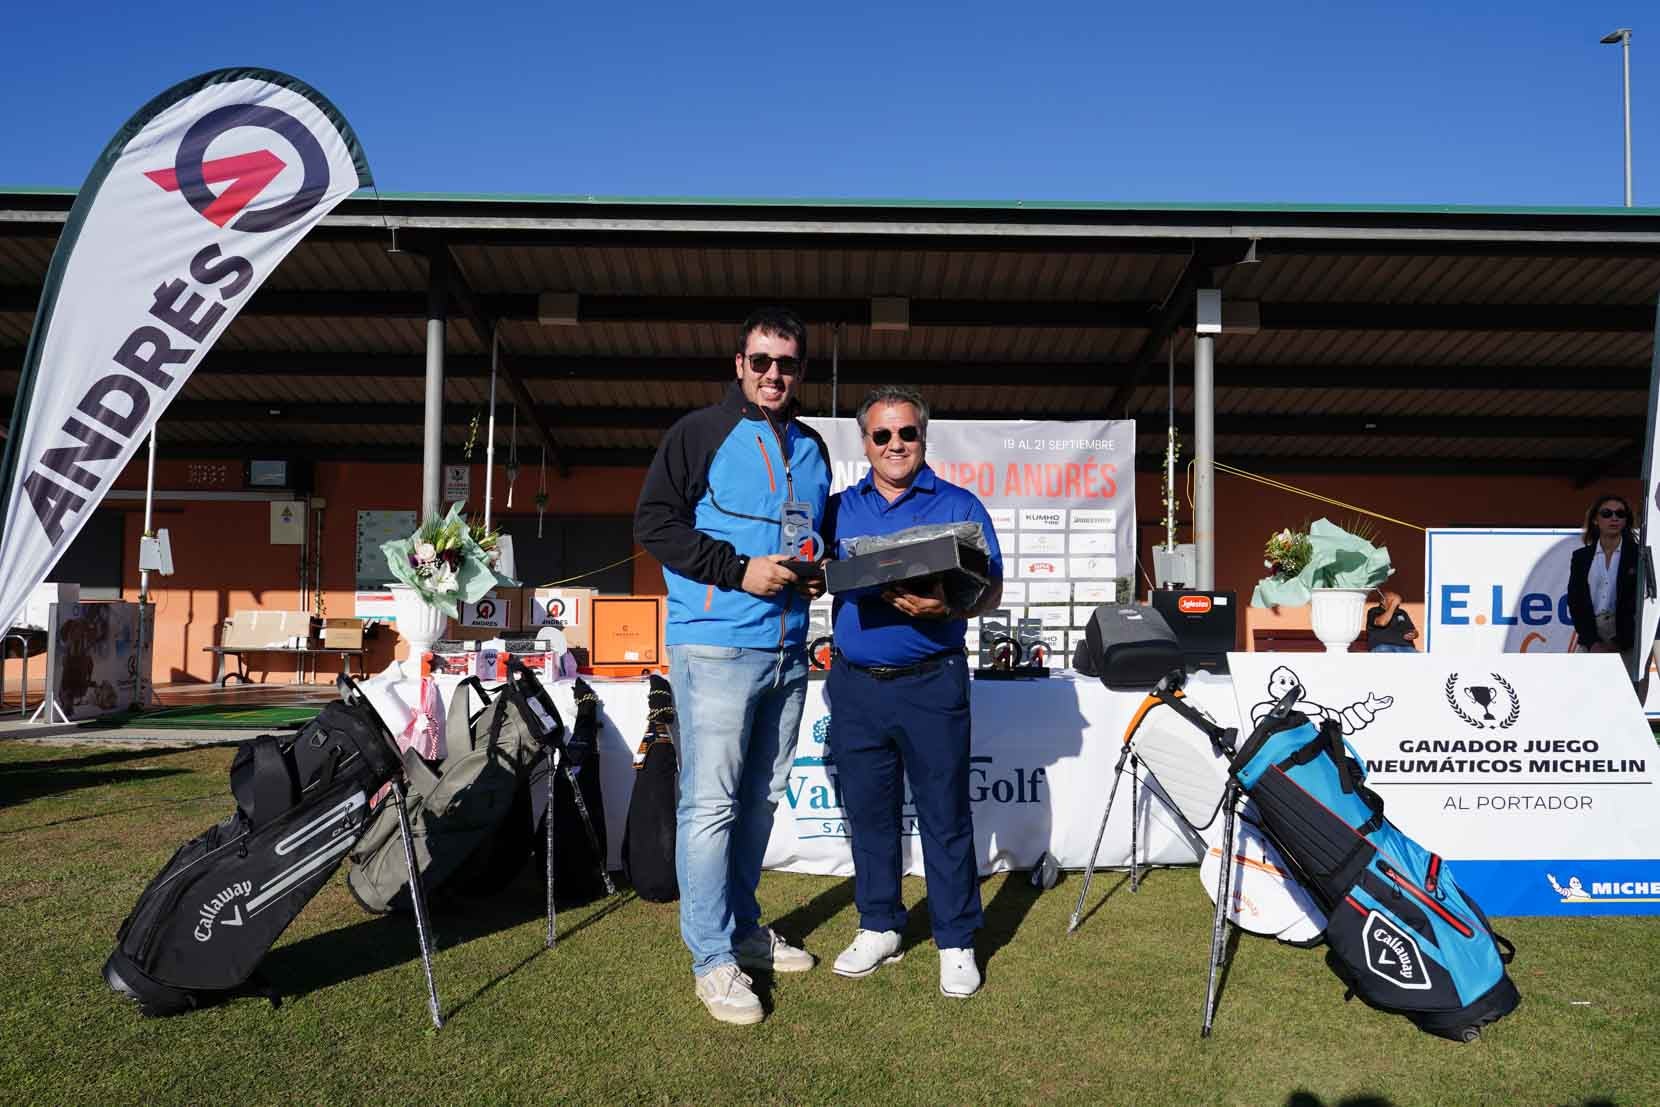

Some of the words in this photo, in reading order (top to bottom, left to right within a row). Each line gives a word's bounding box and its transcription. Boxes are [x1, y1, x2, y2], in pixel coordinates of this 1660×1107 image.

[23, 243, 254, 547] ANDRÉS
[1018, 439, 1033, 450] AL
[1048, 439, 1115, 450] SEPTIEMBRE
[1003, 456, 1118, 498] ANDRÉS
[1400, 740, 1518, 753] GANADOR
[1524, 740, 1599, 753] JUEGO
[1367, 756, 1522, 773] NEUMÁTICOS
[1529, 759, 1646, 773] MICHELIN
[968, 767, 1045, 803] Golf
[1443, 796, 1470, 810] AL
[1477, 796, 1593, 810] PORTADOR
[1592, 882, 1660, 895] MICHE
[194, 879, 253, 942] Callaway
[1373, 928, 1414, 979] Callaway
